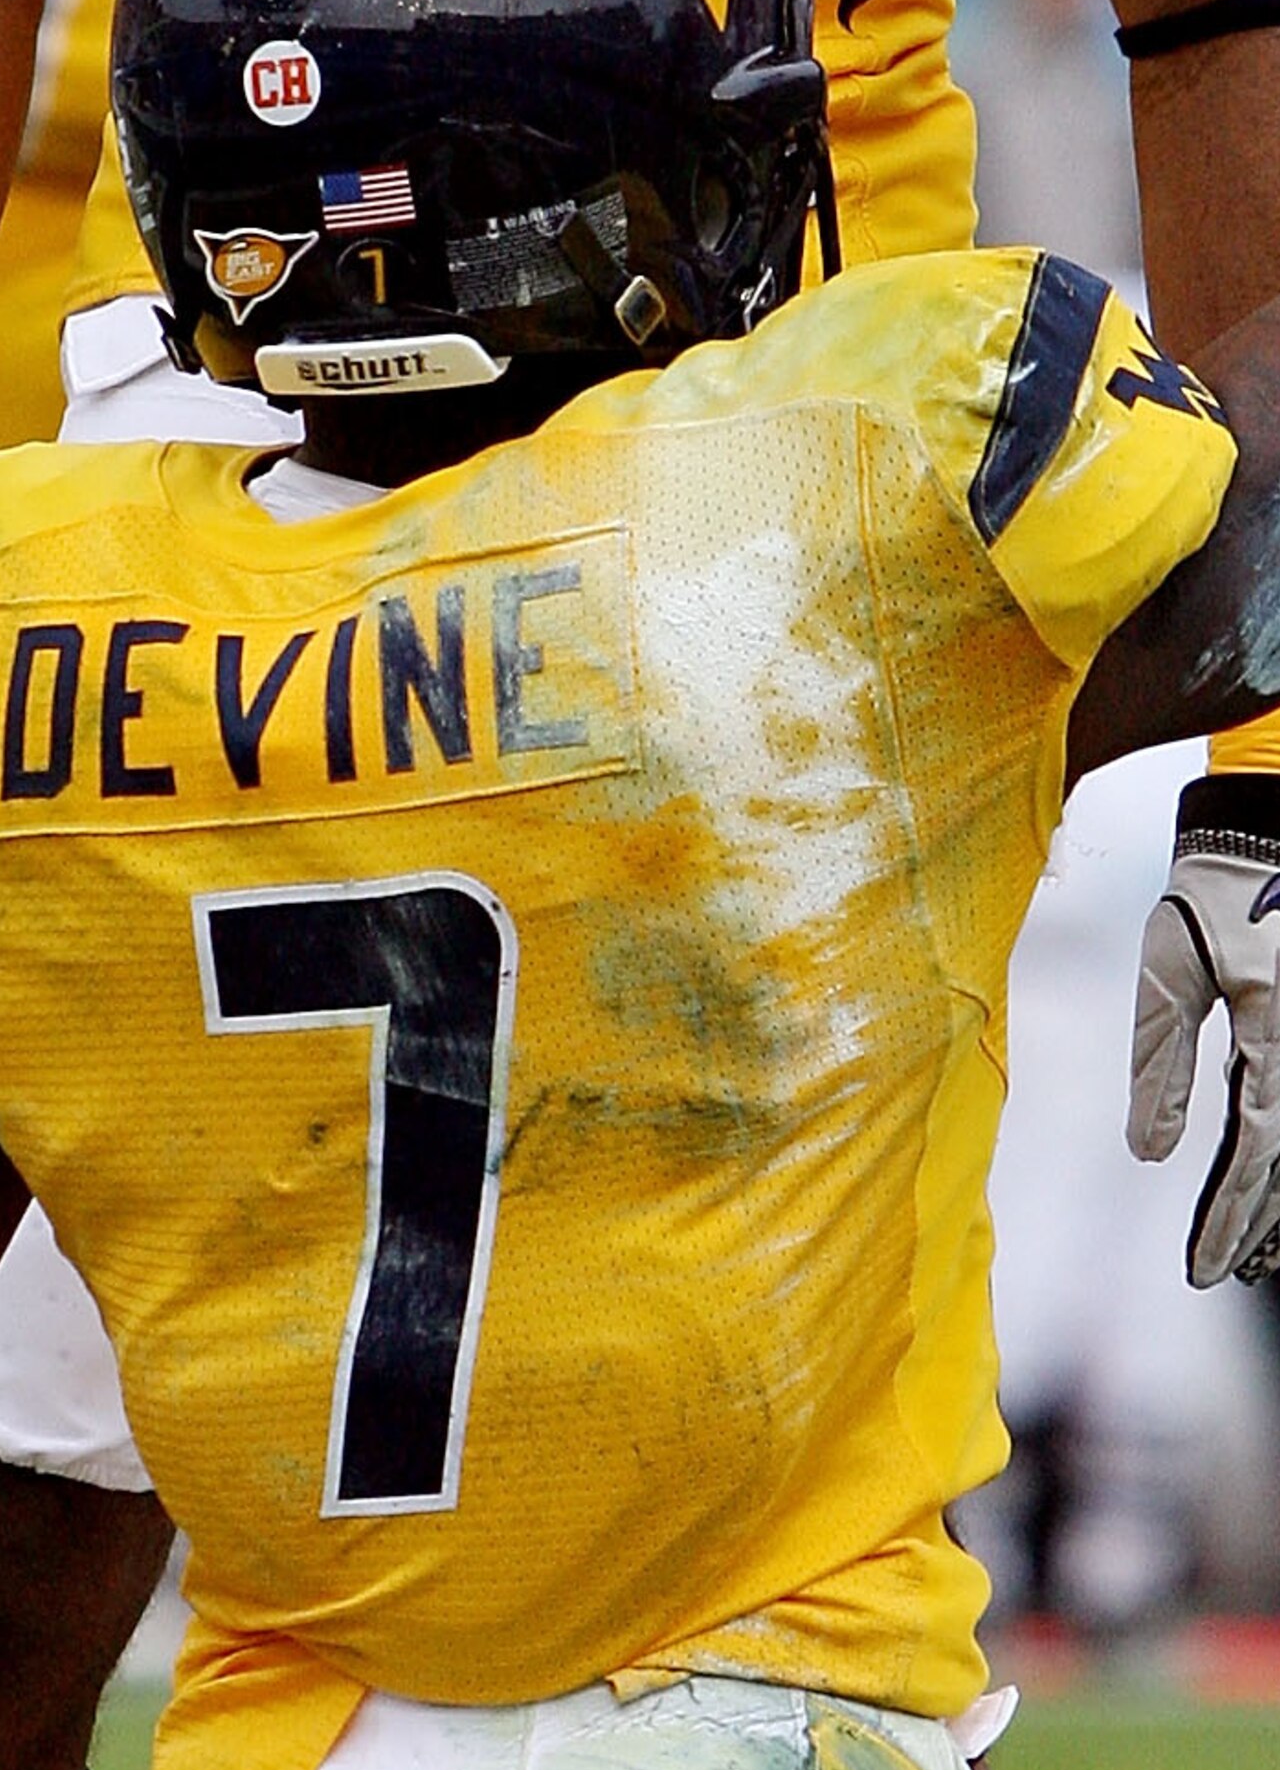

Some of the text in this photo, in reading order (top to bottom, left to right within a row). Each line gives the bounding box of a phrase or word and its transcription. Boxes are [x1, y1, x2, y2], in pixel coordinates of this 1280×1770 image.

[251, 56, 312, 109] CH
[0, 562, 589, 802] DEVINE
[191, 869, 520, 1520] 7
